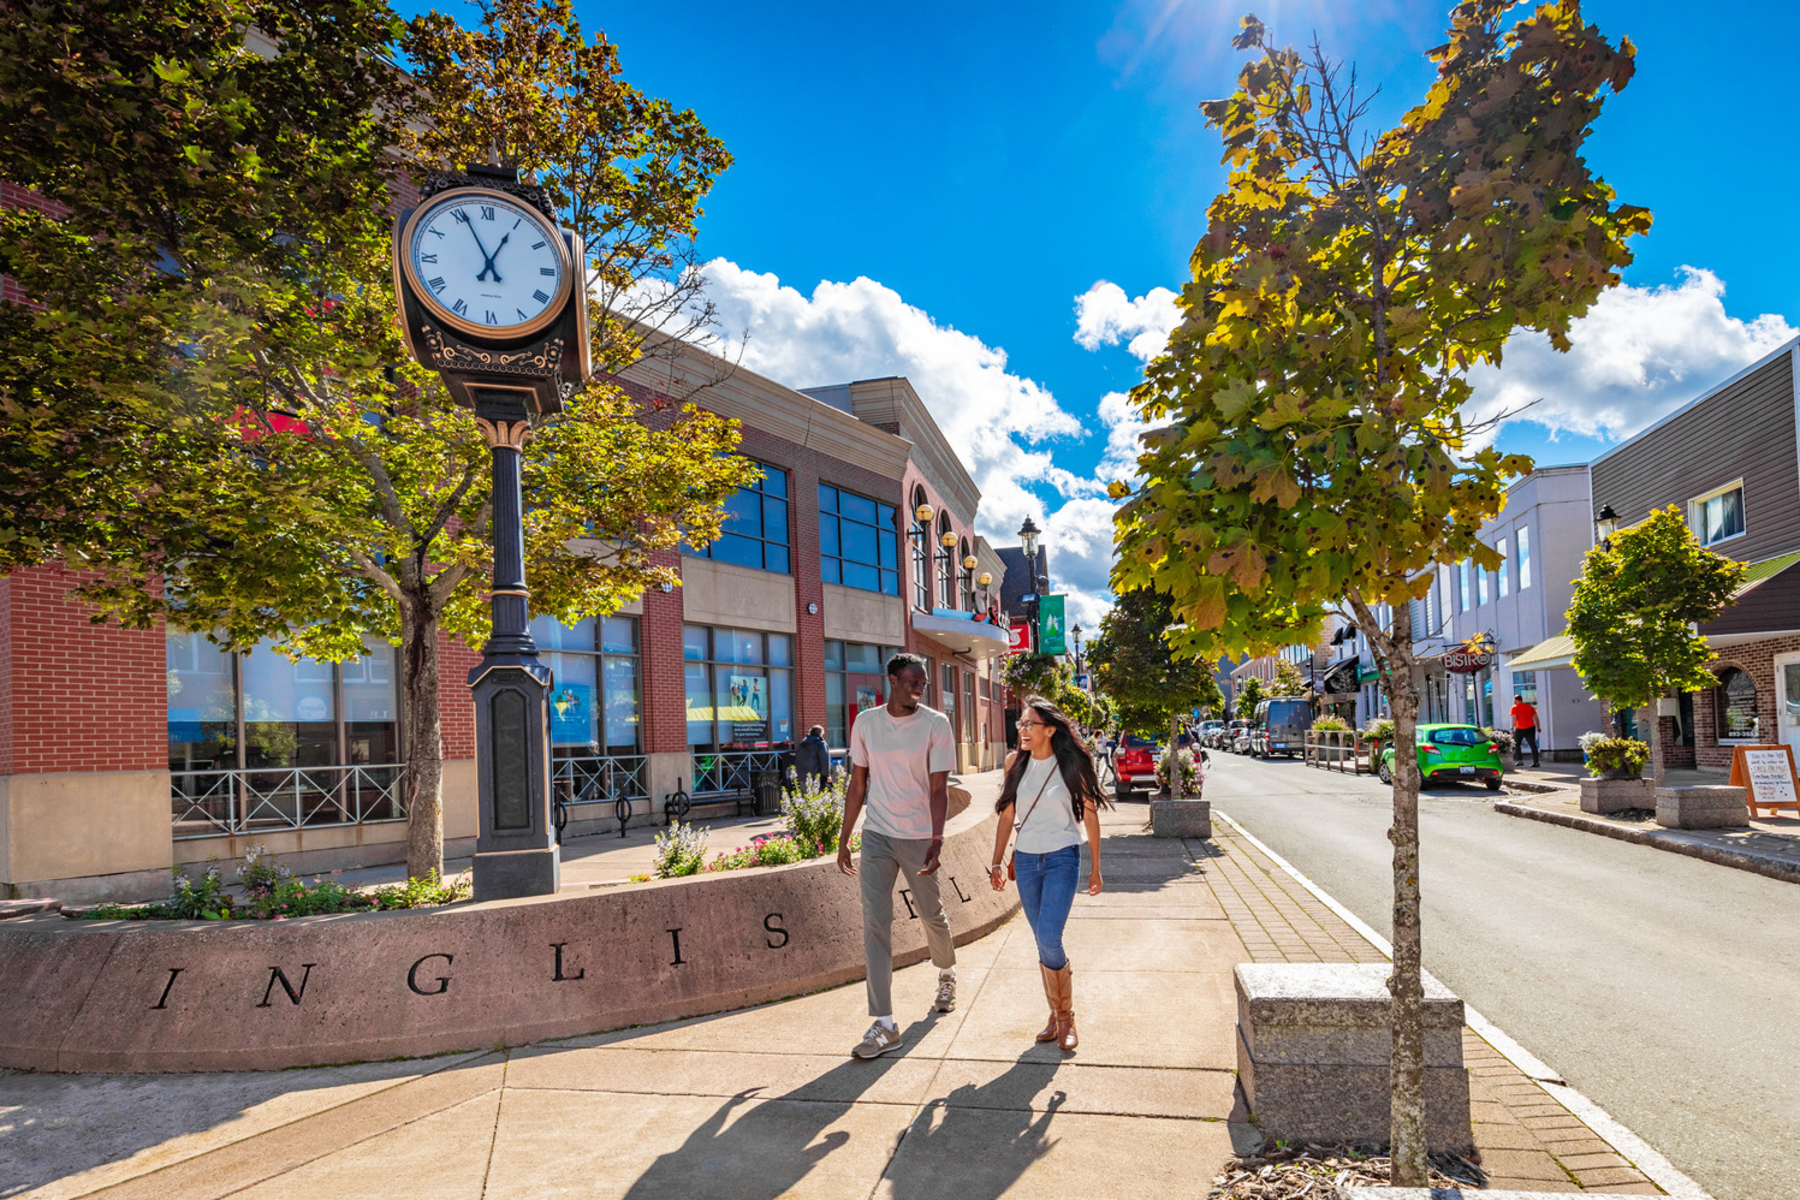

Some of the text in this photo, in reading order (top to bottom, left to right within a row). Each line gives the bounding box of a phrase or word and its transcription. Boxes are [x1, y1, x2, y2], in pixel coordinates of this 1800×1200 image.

[480, 206, 495, 221] XII
[428, 226, 446, 240] X
[150, 912, 791, 1010] INGLIS
[875, 1033, 889, 1047] N
